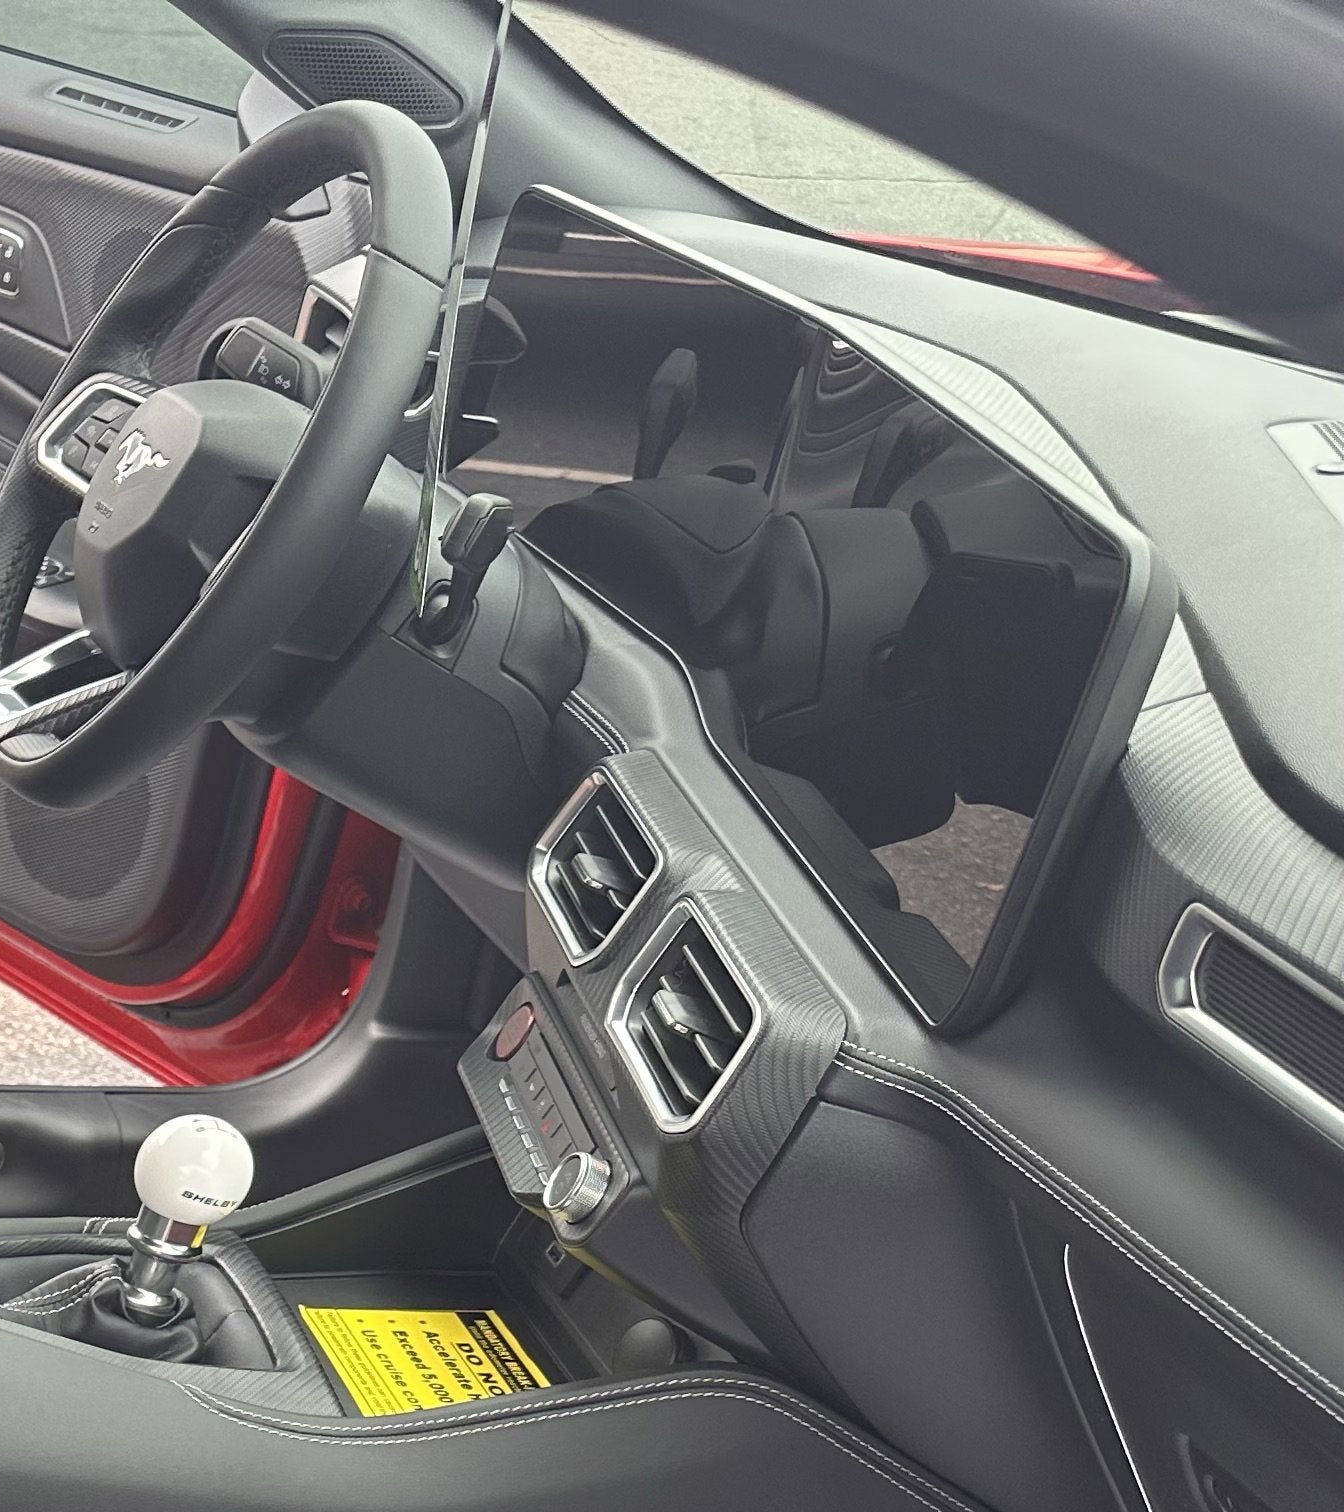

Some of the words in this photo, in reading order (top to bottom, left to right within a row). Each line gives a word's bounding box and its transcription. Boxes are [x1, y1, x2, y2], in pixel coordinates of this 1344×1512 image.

[181, 1190, 237, 1208] SHELBY
[360, 1329, 382, 1350] Use
[376, 1353, 407, 1387] cruise
[392, 1330, 431, 1370] Exceed
[421, 1373, 454, 1403] 5,000
[422, 1330, 473, 1390] Accelerate
[456, 1342, 483, 1366] DO
[477, 1372, 507, 1397] NO
